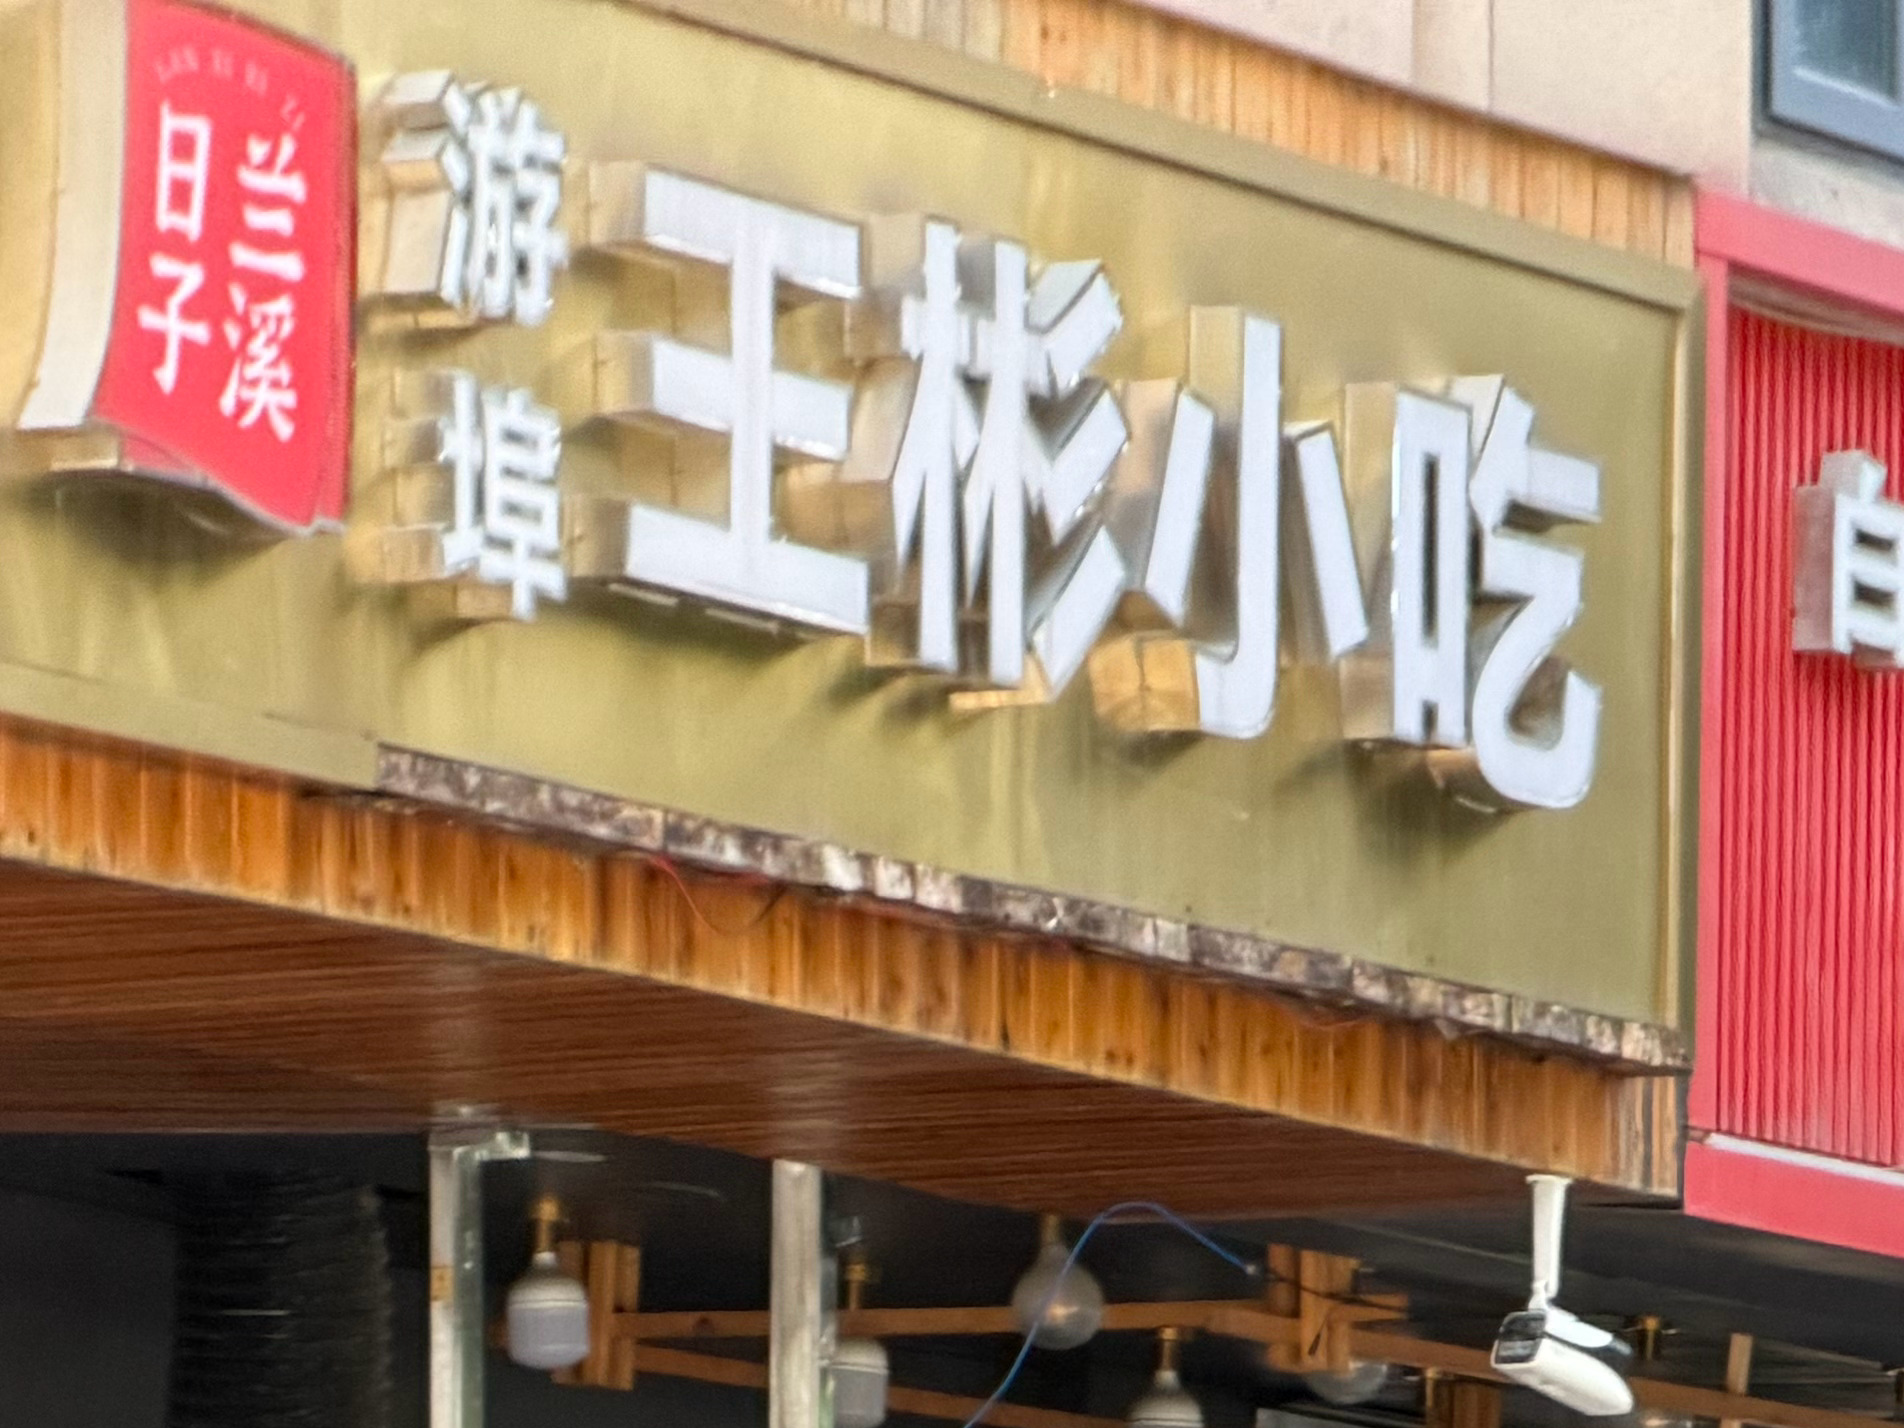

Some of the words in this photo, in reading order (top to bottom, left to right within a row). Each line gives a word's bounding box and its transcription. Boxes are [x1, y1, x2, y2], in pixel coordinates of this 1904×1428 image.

[137, 100, 213, 396] 日子
[219, 133, 307, 443] 兰溪
[440, 83, 568, 620] 游埠
[612, 165, 1602, 808] 王彬小吃
